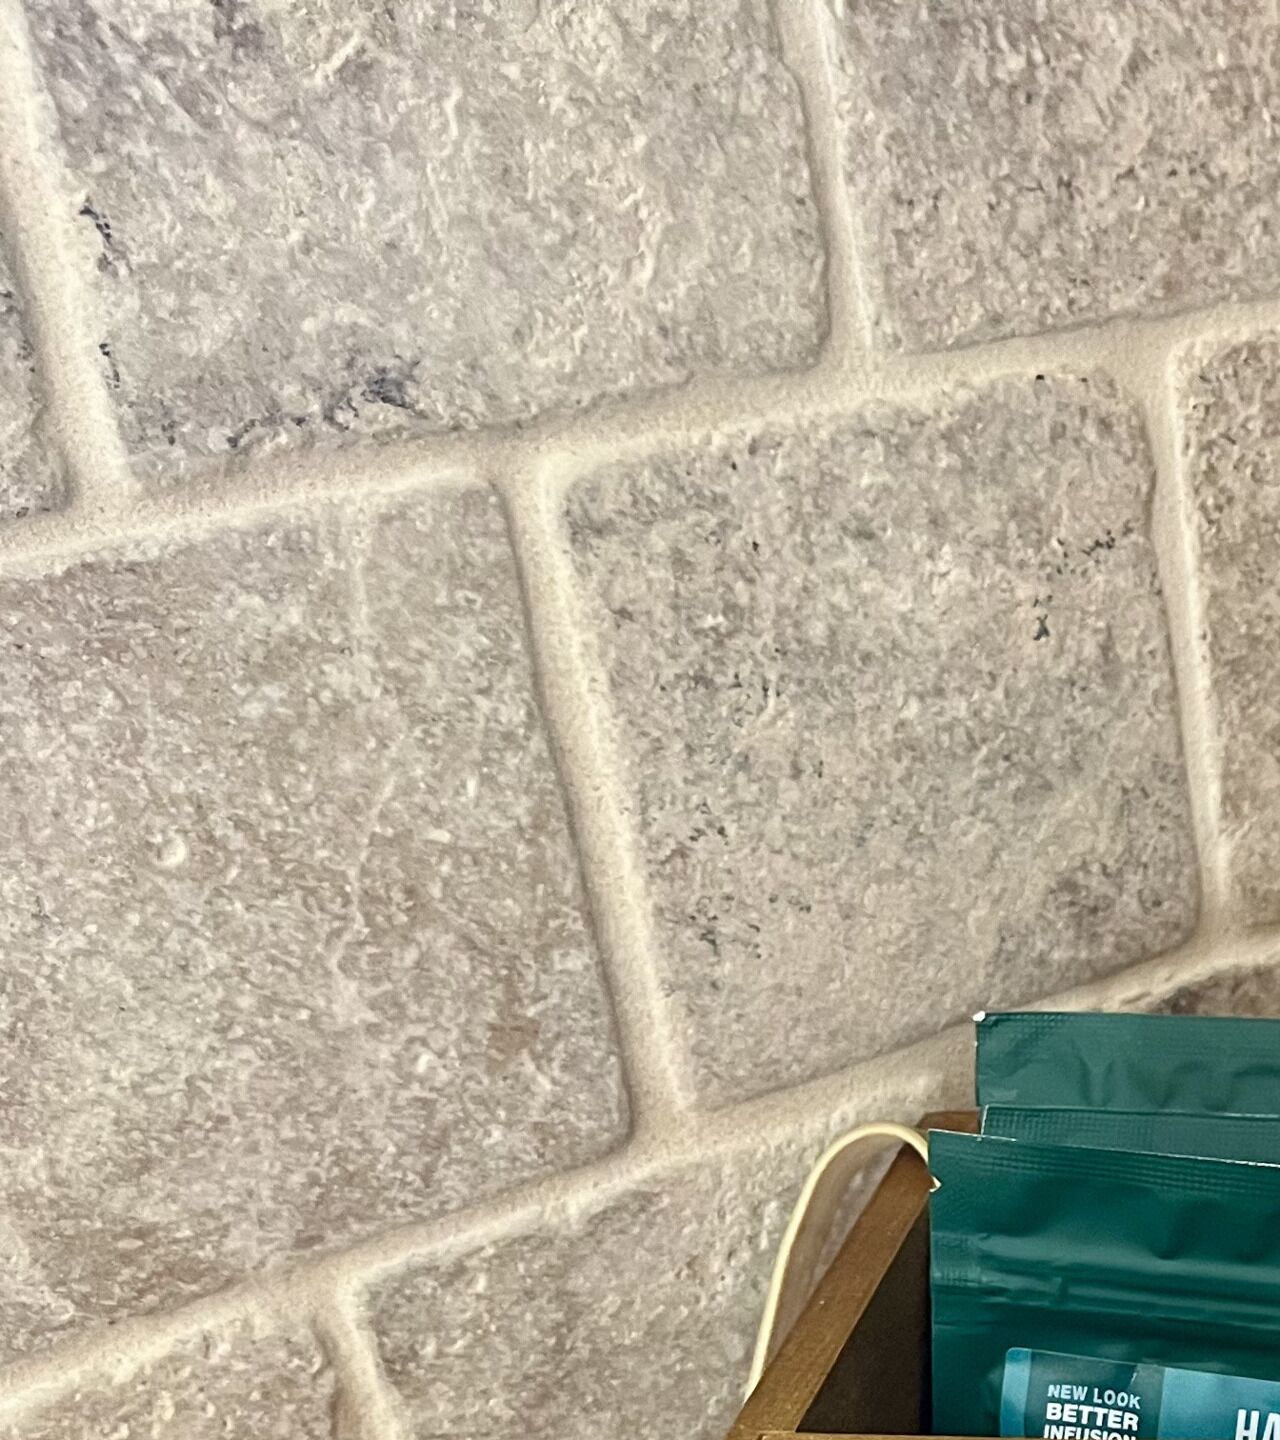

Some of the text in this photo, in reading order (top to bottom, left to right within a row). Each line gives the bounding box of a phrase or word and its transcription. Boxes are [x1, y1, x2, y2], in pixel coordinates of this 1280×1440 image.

[1047, 1384, 1141, 1410] NEW LOOK
[1045, 1402, 1140, 1432] BETTER
